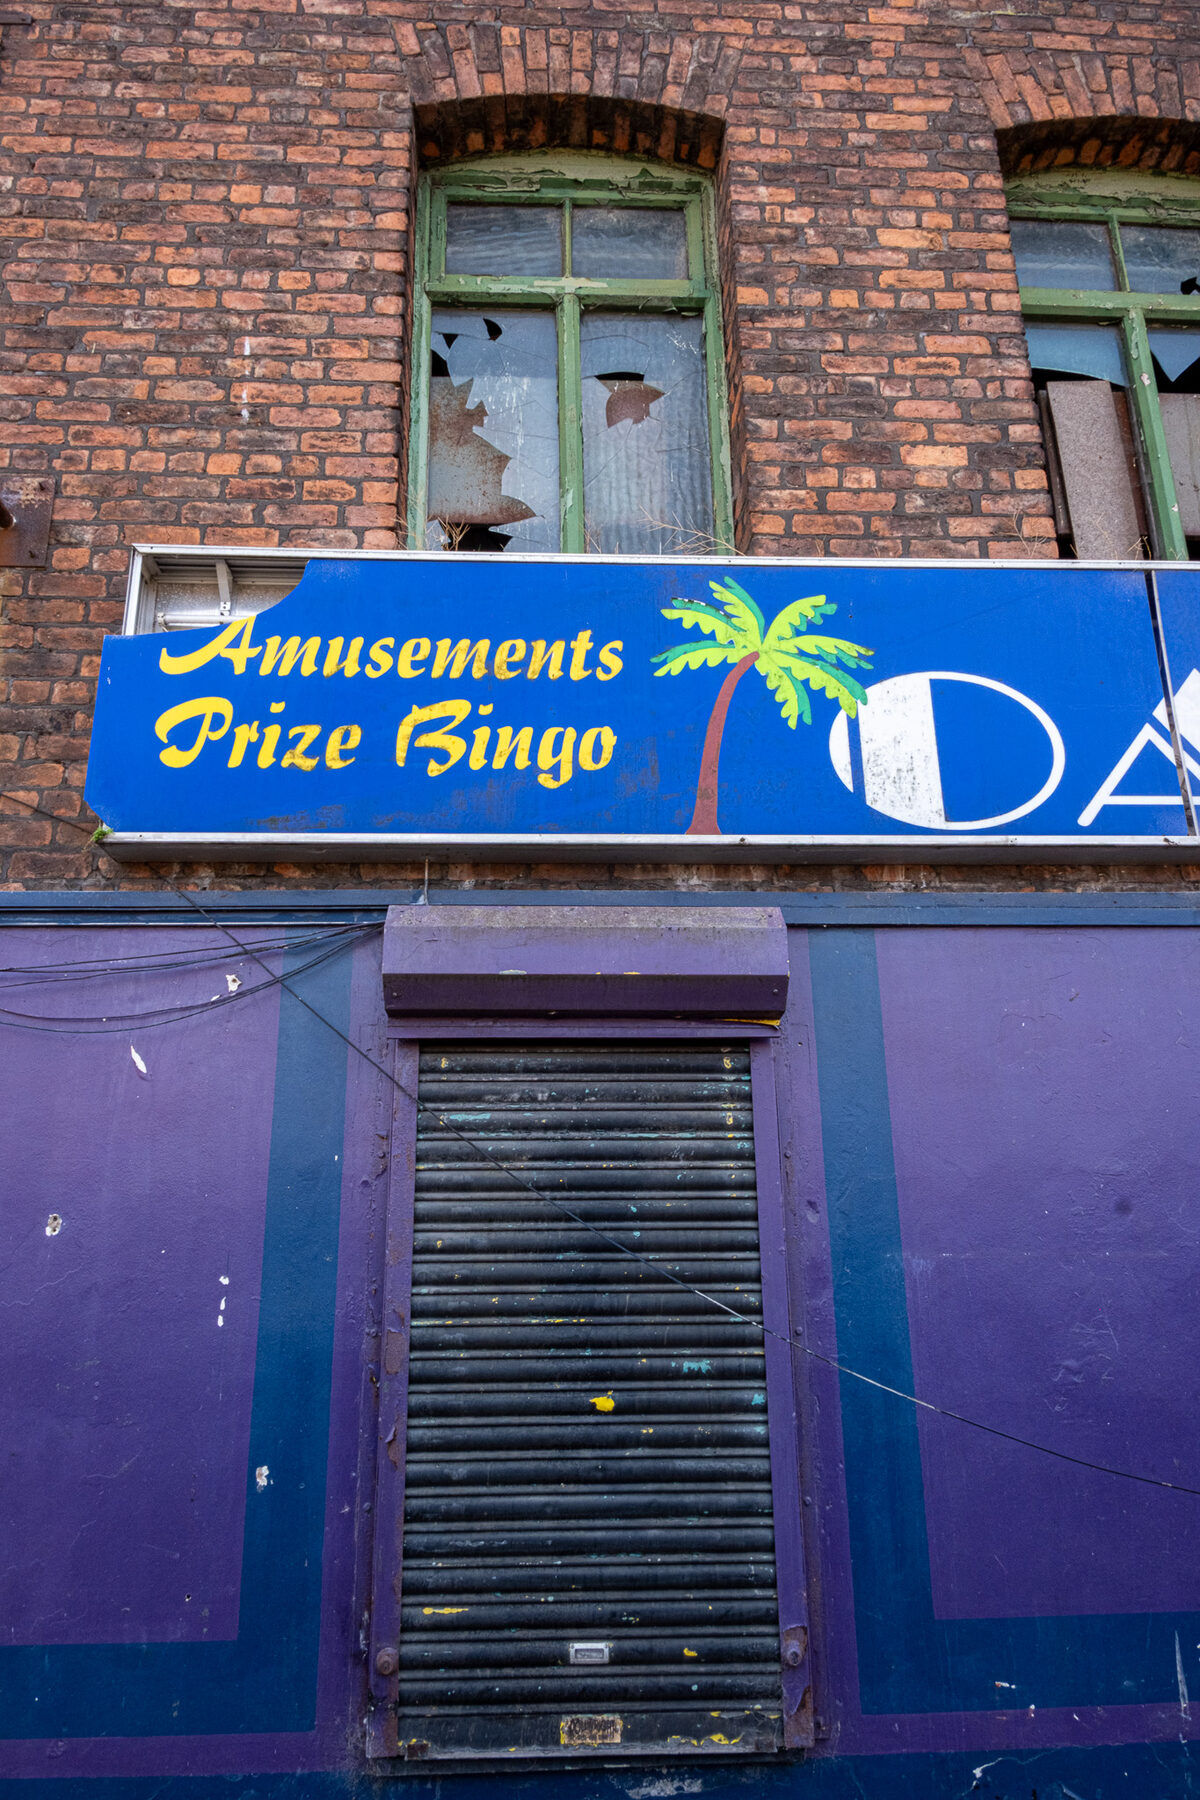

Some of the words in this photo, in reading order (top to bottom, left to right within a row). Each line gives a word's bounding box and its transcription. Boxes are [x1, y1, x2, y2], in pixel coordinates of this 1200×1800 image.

[159, 615, 624, 682] Amusements
[154, 696, 362, 770] Prize
[396, 699, 618, 789] Bingo
